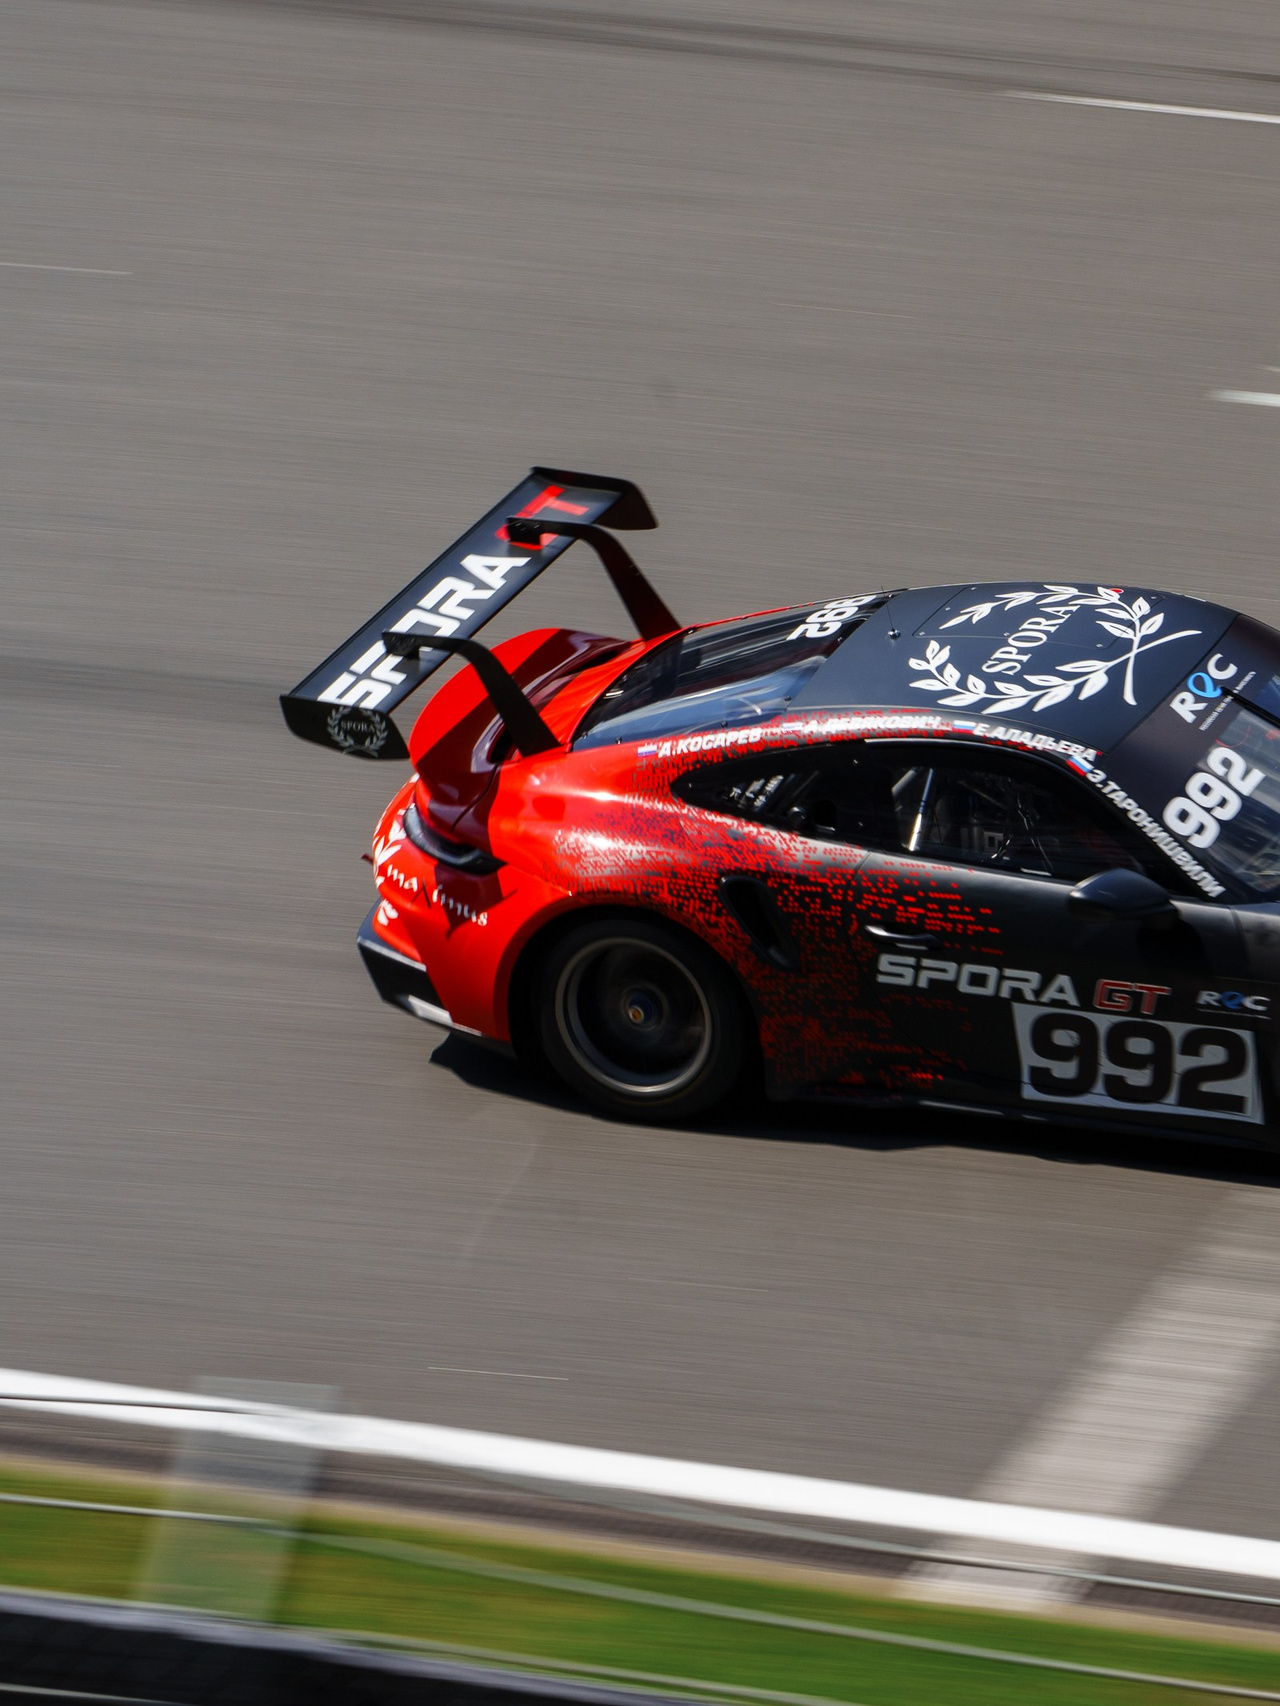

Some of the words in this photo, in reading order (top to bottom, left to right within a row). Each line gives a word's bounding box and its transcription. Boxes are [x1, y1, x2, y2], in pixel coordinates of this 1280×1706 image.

[981, 604, 1081, 676] SPORA
[340, 719, 375, 733] SPORA
[1162, 746, 1266, 849] 992
[876, 953, 1081, 1007] SPORA
[1092, 978, 1172, 1015] GT
[1026, 1012, 1250, 1115] 992
